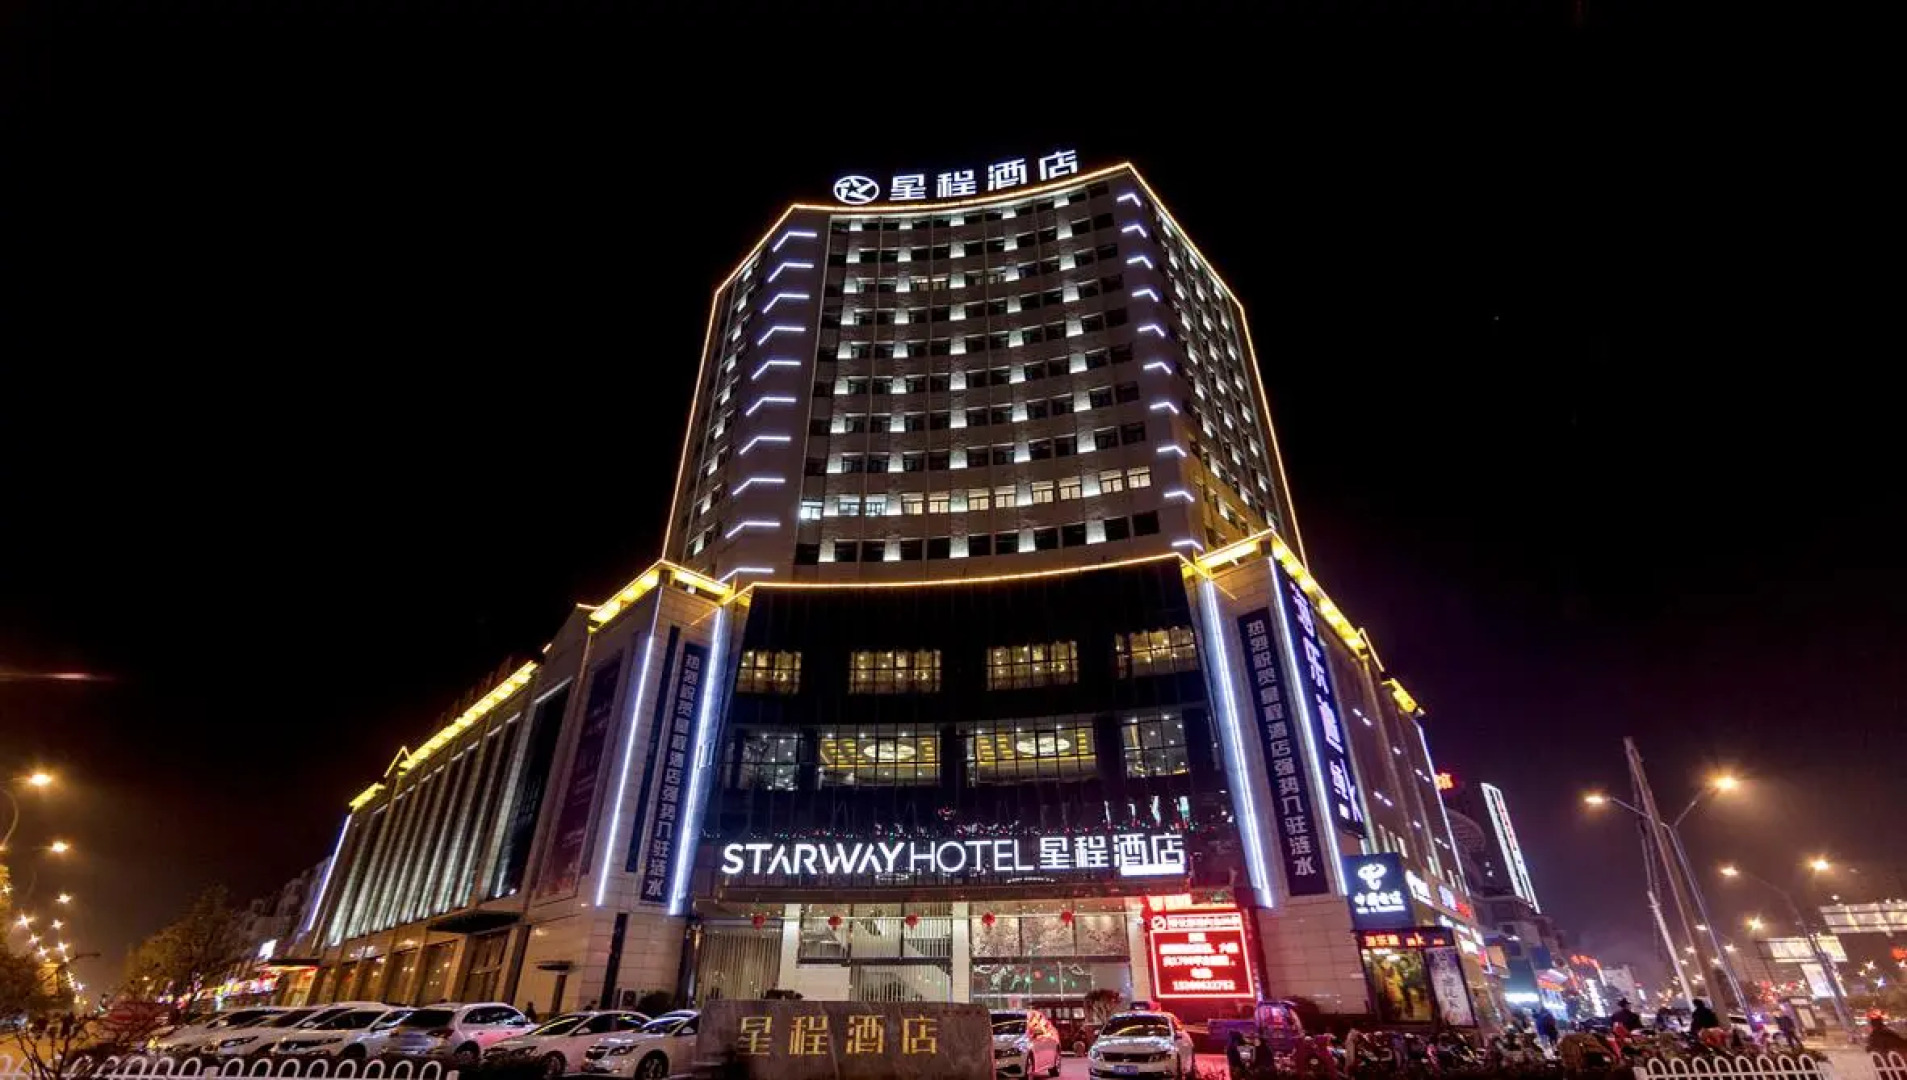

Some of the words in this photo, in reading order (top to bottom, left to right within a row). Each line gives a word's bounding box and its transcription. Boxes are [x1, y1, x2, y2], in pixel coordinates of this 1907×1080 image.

[889, 149, 1079, 201] 星程酒店
[721, 841, 905, 875] STARWAY
[909, 839, 1034, 873] HOTEL
[1039, 833, 1187, 870] 星程酒店
[736, 1013, 939, 1056] 星程酒店
